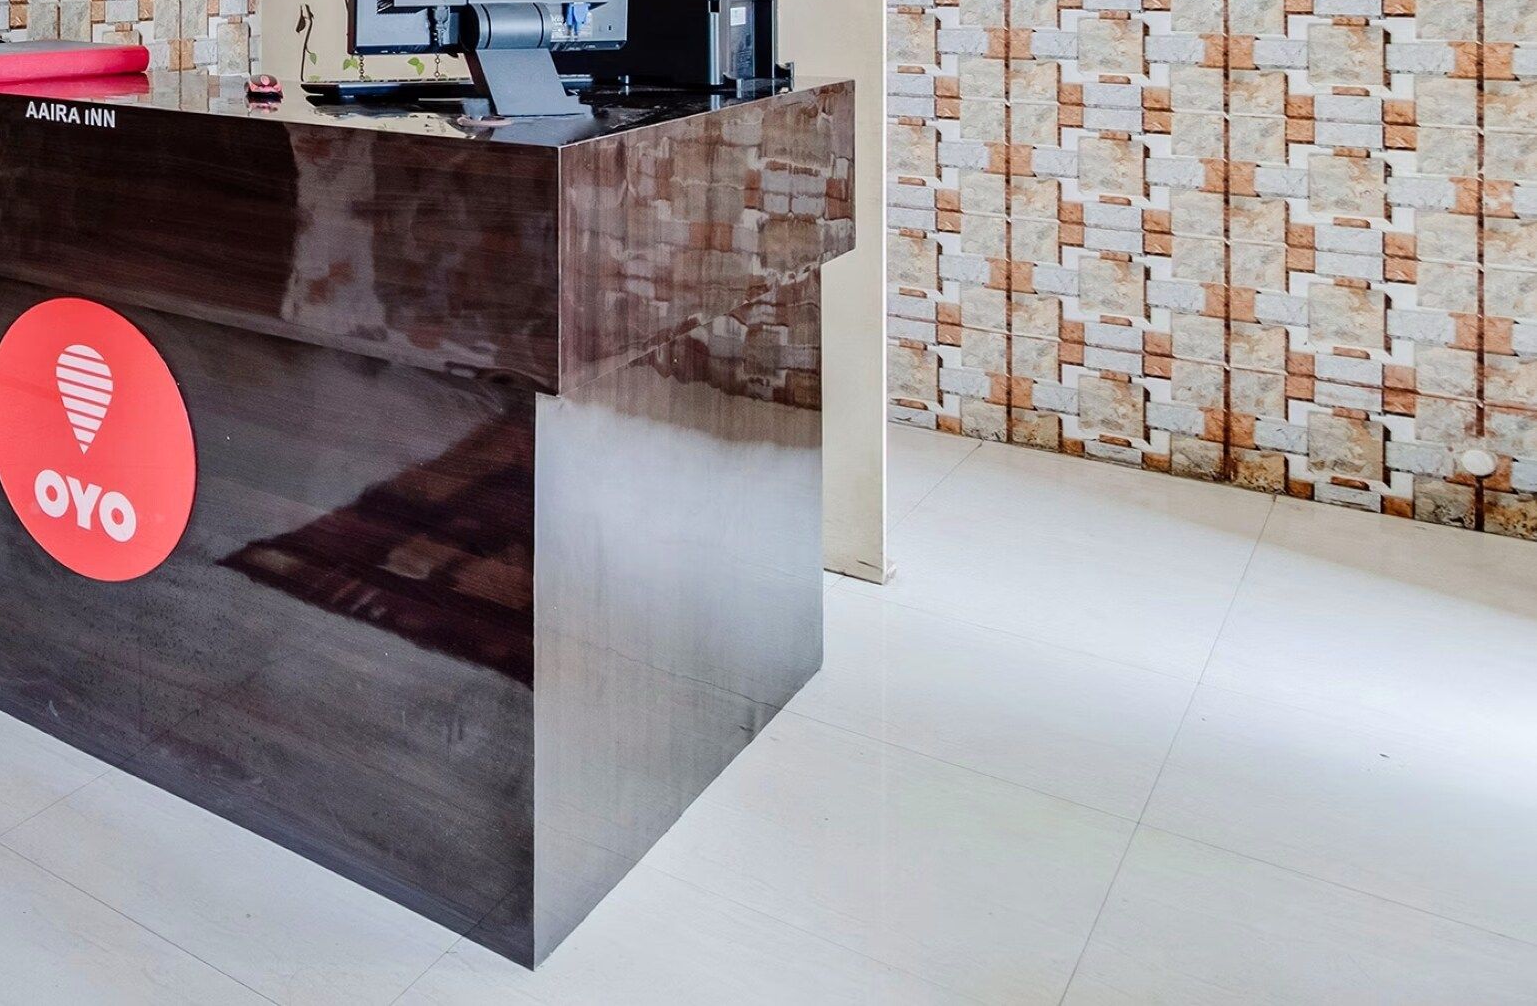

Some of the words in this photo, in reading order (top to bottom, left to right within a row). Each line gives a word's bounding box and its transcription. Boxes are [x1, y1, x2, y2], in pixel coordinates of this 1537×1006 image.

[25, 100, 81, 125] AAIRA
[84, 107, 116, 128] INN
[34, 469, 136, 542] OYO
